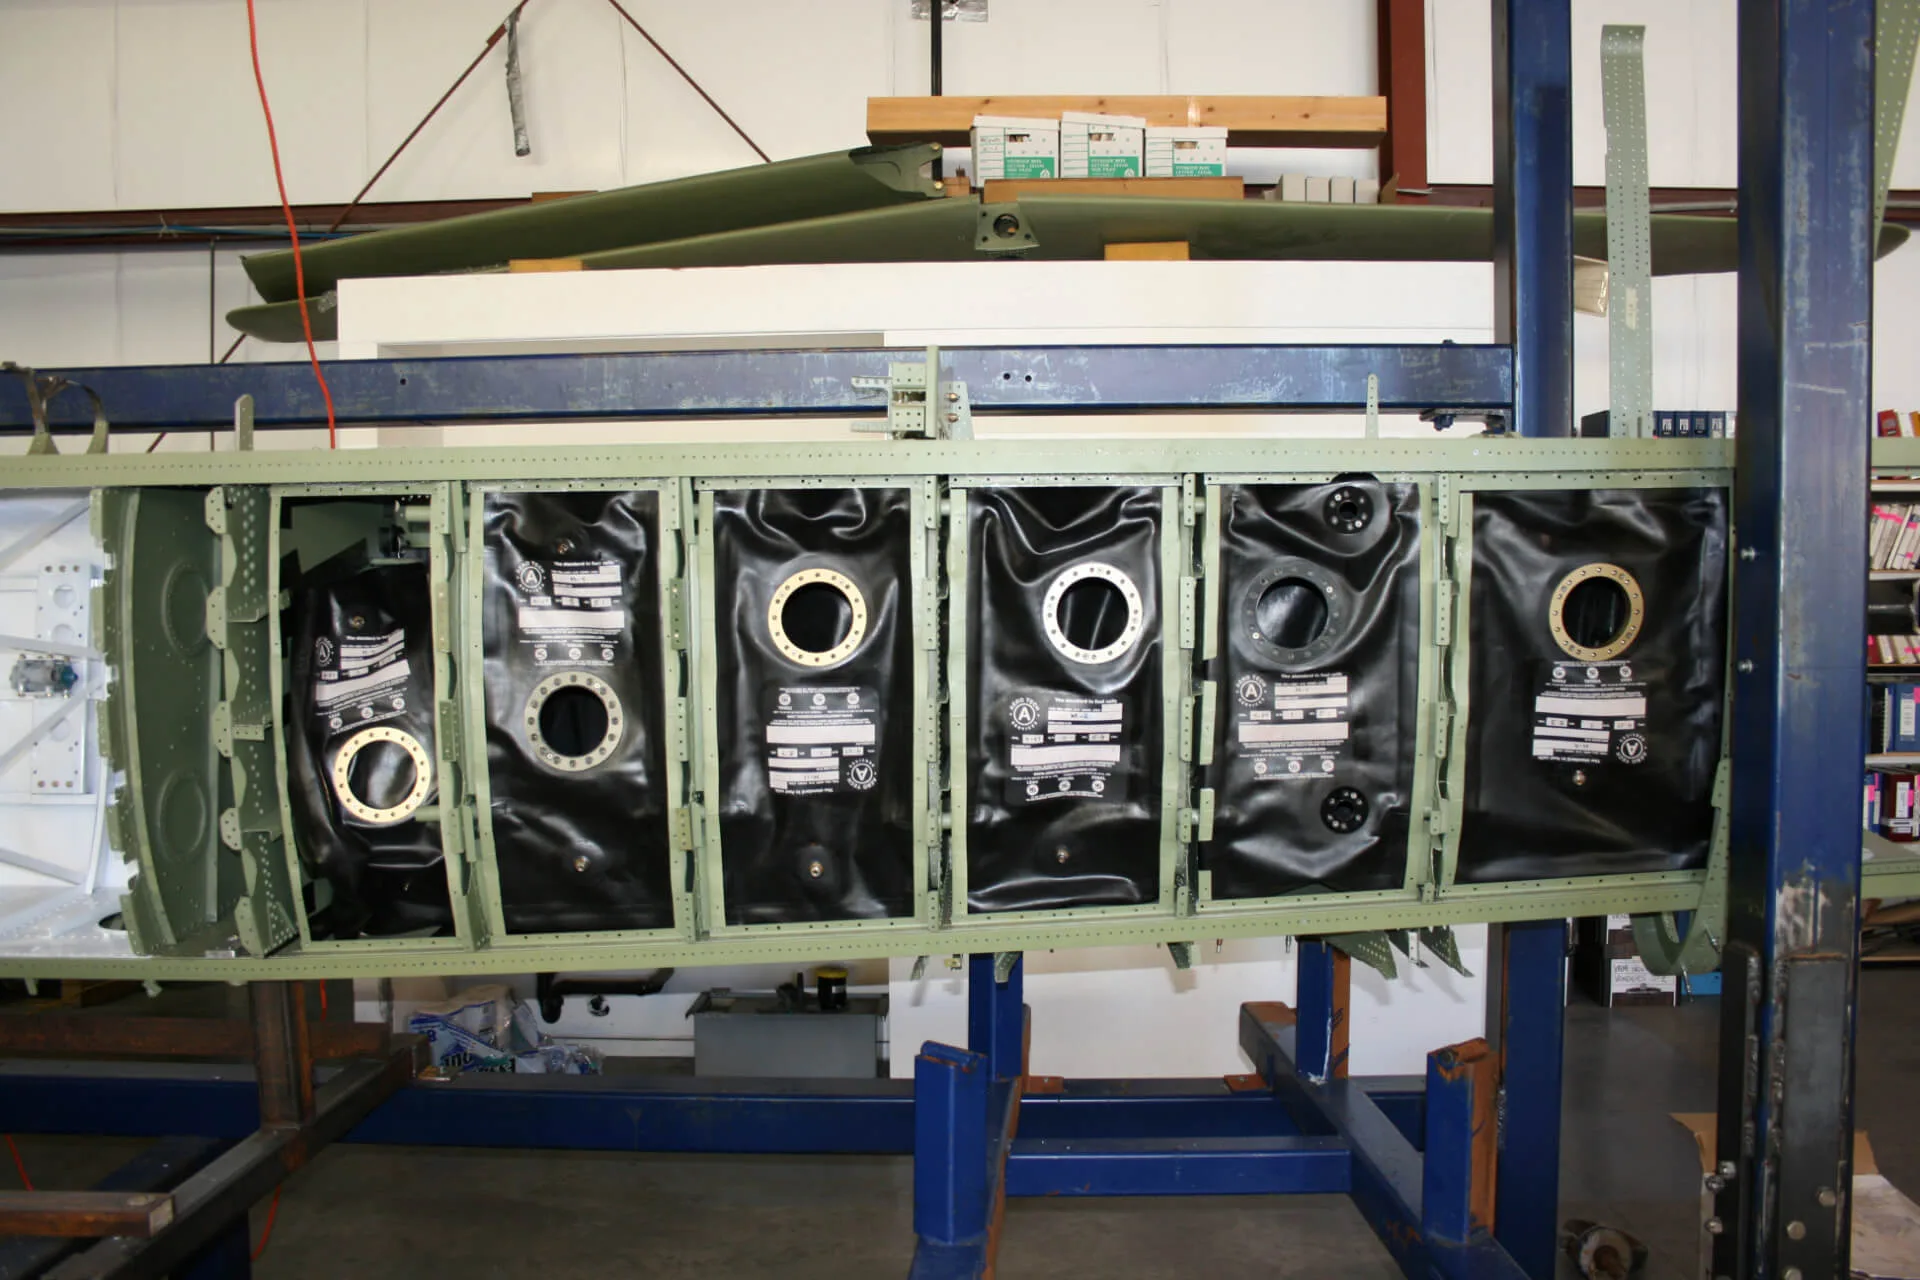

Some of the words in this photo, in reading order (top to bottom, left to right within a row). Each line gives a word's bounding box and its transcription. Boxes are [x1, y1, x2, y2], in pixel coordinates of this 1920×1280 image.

[525, 570, 537, 583] A
[1245, 684, 1257, 697] A
[1018, 707, 1031, 721] A
[1626, 742, 1638, 756] A
[856, 768, 867, 781] A
